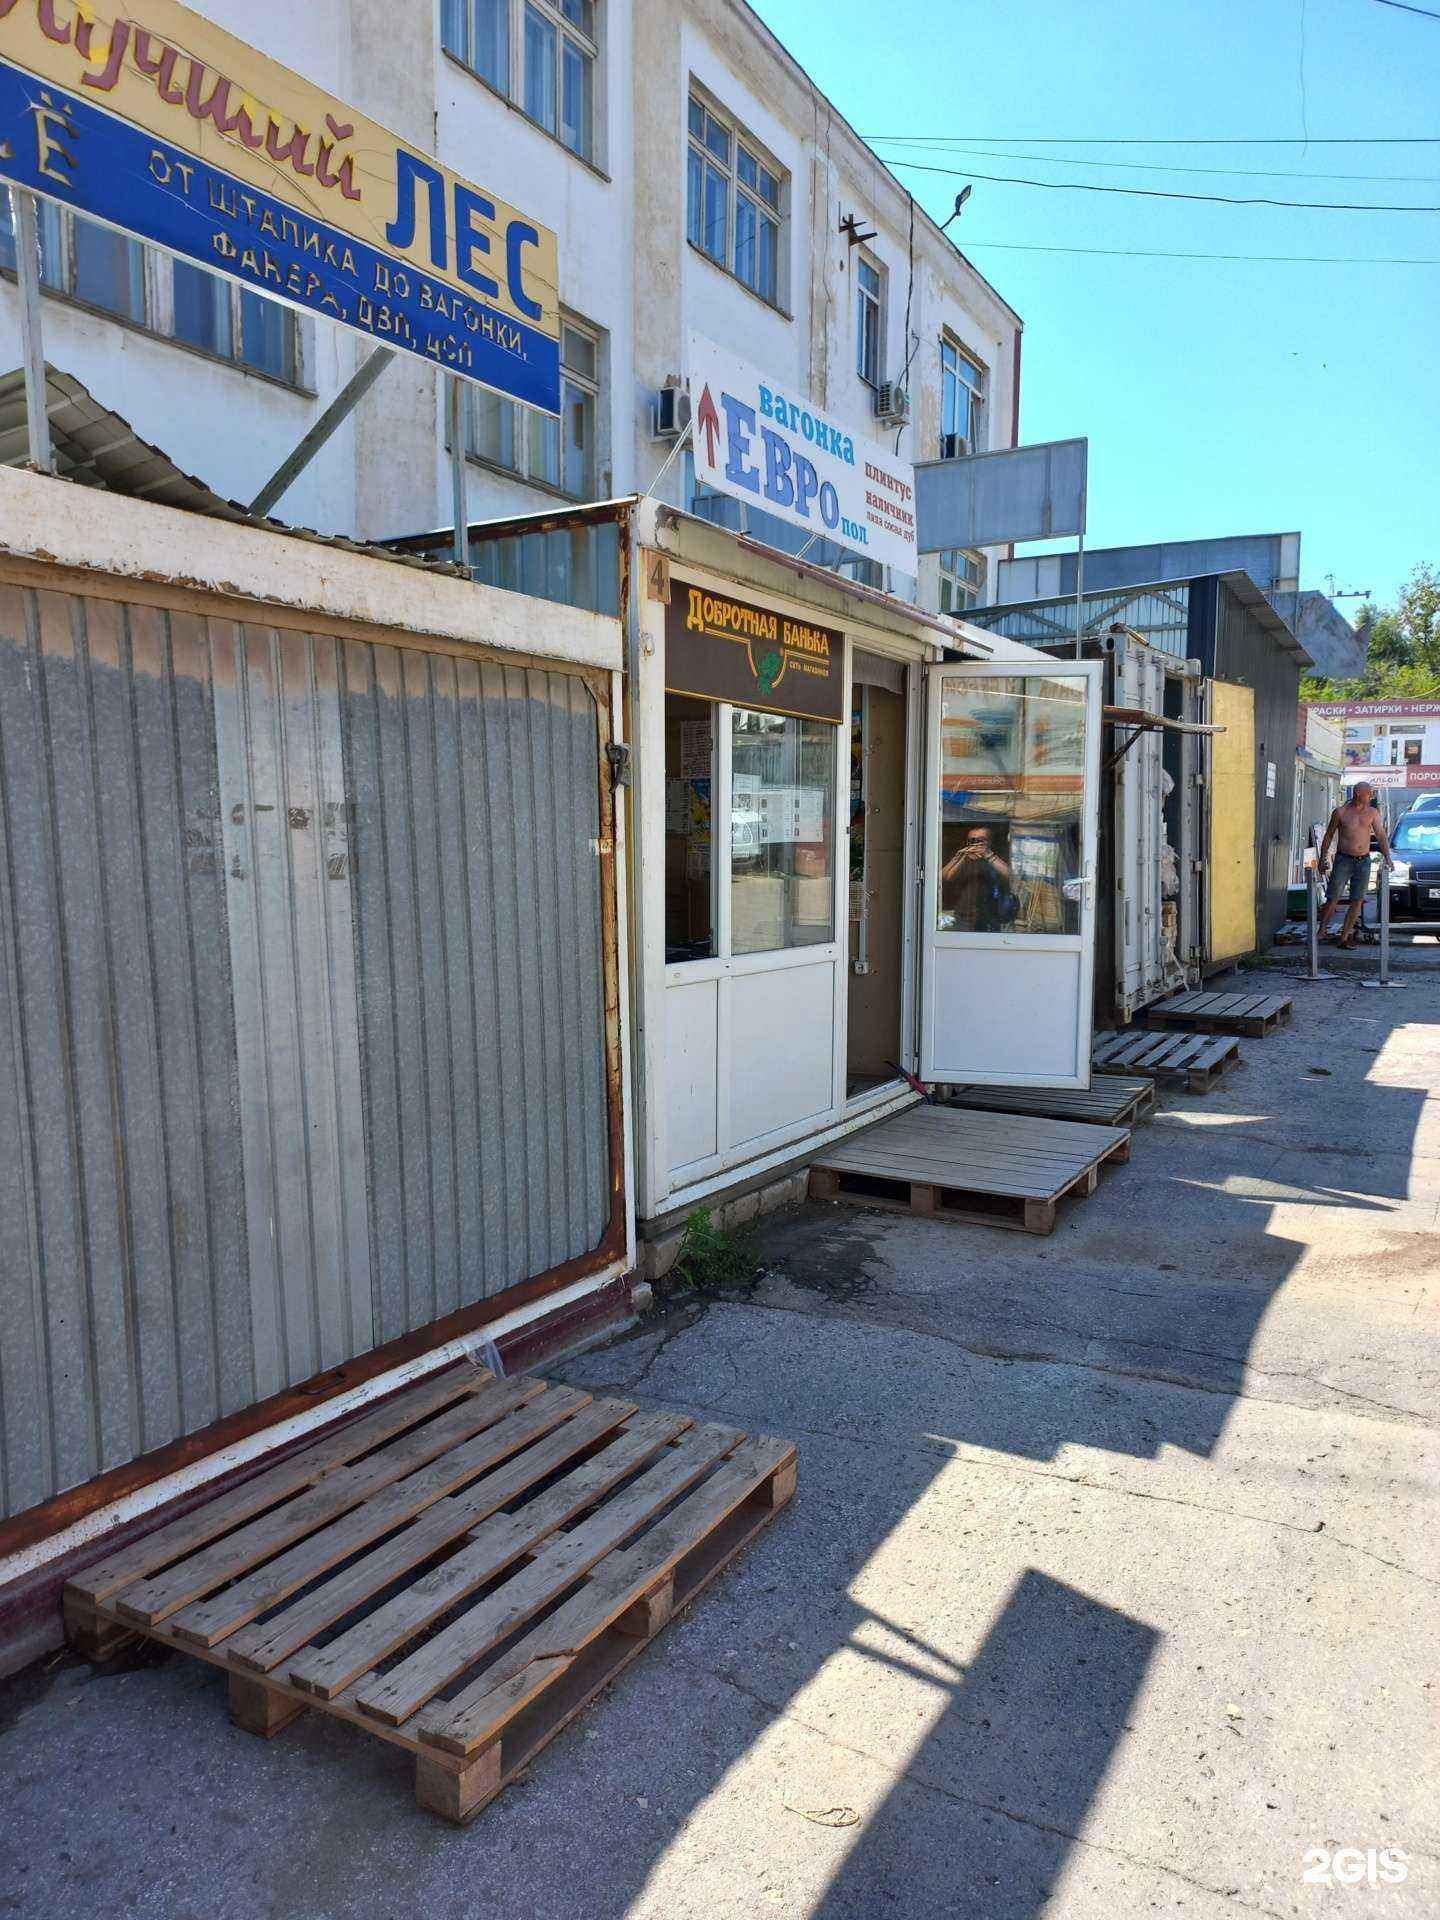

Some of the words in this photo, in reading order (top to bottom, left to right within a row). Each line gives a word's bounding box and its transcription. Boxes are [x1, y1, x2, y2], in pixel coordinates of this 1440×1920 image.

[148, 150, 194, 194] ОТ
[208, 176, 359, 278] ШТАПИКА
[373, 261, 410, 299] ДО
[385, 148, 543, 322] ЛЕС
[758, 384, 855, 466] вагонка
[721, 391, 839, 530] ЕВРО
[841, 517, 868, 545] пол
[865, 462, 912, 502] плинтус
[865, 490, 915, 527] наличник
[650, 559, 665, 594] 4
[687, 588, 778, 641] ДОБРОТНАЯ
[783, 621, 830, 656] БАНЬКА
[1354, 704, 1402, 714] ЗАТИРКИ
[1409, 772, 1440, 781] ПОРО
